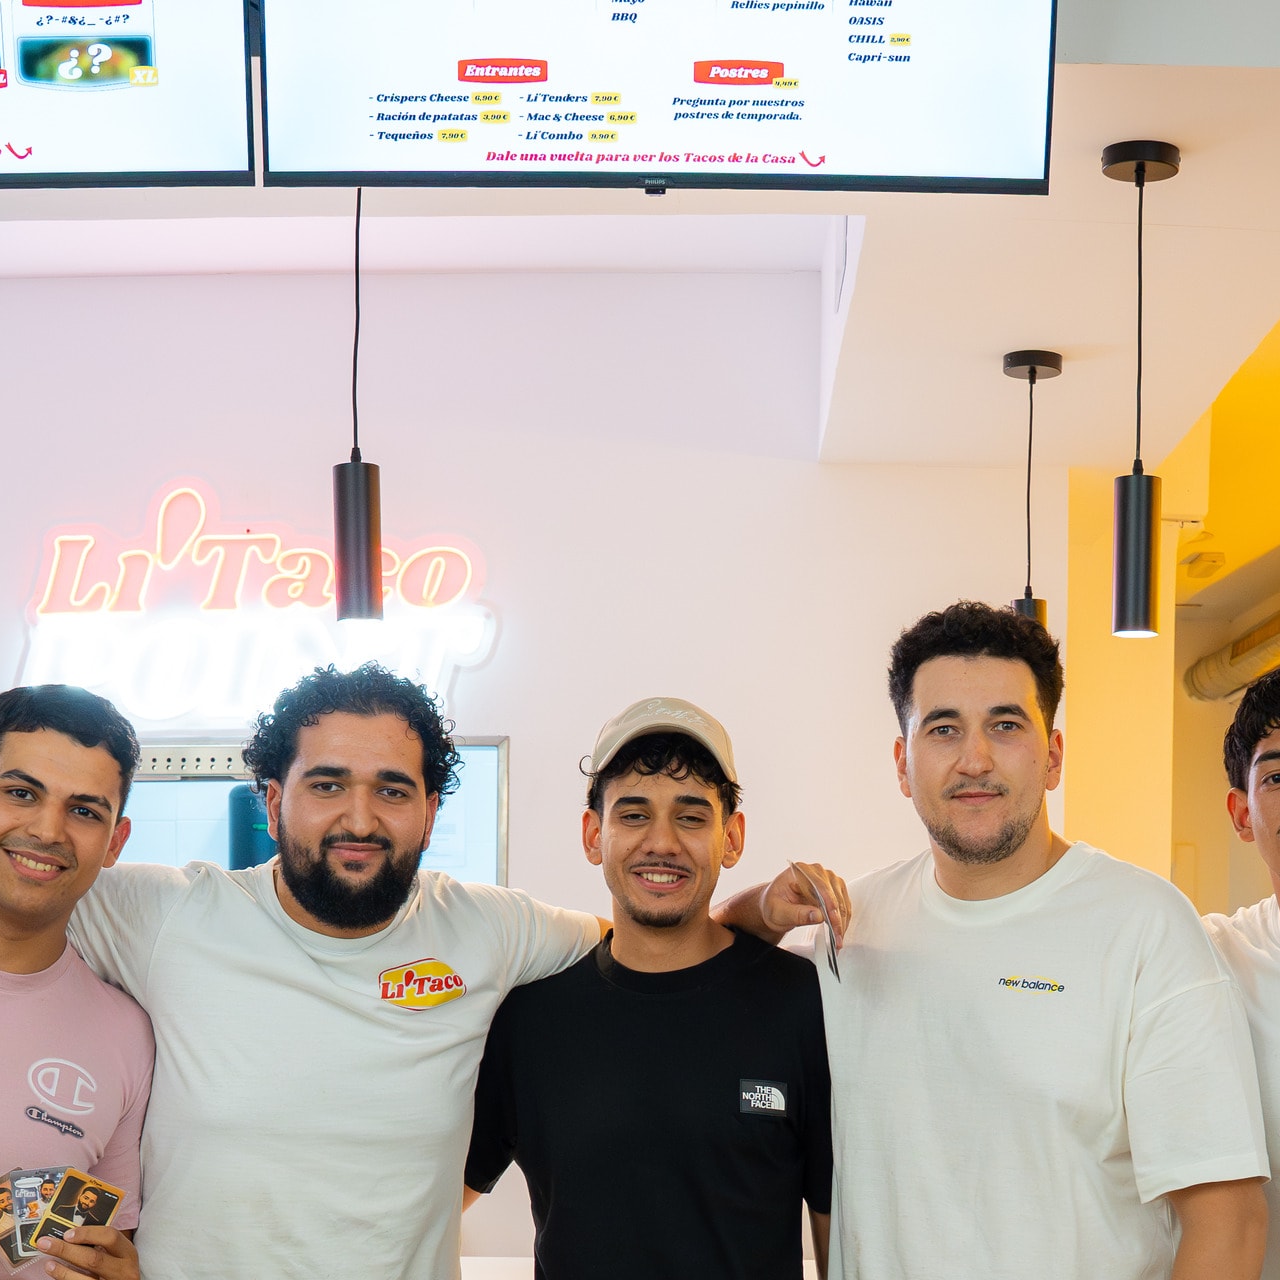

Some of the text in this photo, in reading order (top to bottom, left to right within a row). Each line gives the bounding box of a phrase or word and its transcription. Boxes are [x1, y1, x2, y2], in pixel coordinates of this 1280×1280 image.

[772, 1, 825, 12] pepinillo
[611, 12, 638, 24] BBQ
[848, 16, 885, 26] OASIS
[848, 34, 886, 44] CHILL
[847, 52, 911, 64] Capri-sun
[131, 69, 157, 83] XL
[464, 64, 541, 77] Entrantes
[709, 66, 769, 79] Postres
[376, 93, 427, 105] Crispers
[429, 93, 470, 103] Cheese
[672, 96, 805, 109] Pregunta por nuestros
[376, 111, 416, 122] Ración
[418, 111, 431, 121] de
[432, 113, 478, 124] patatas
[526, 112, 550, 122] Mac
[552, 112, 562, 122] &
[564, 112, 604, 122] Cheese
[673, 110, 803, 123] postres de temporada.
[377, 130, 434, 142] Tequeños
[486, 150, 796, 164] Dale una vuelta para ver los Tacos de la Casa
[998, 977, 1065, 992] new balance
[742, 1092, 772, 1102] NORTH
[751, 1100, 772, 1108] FACE
[26, 1106, 84, 1138] Champion
